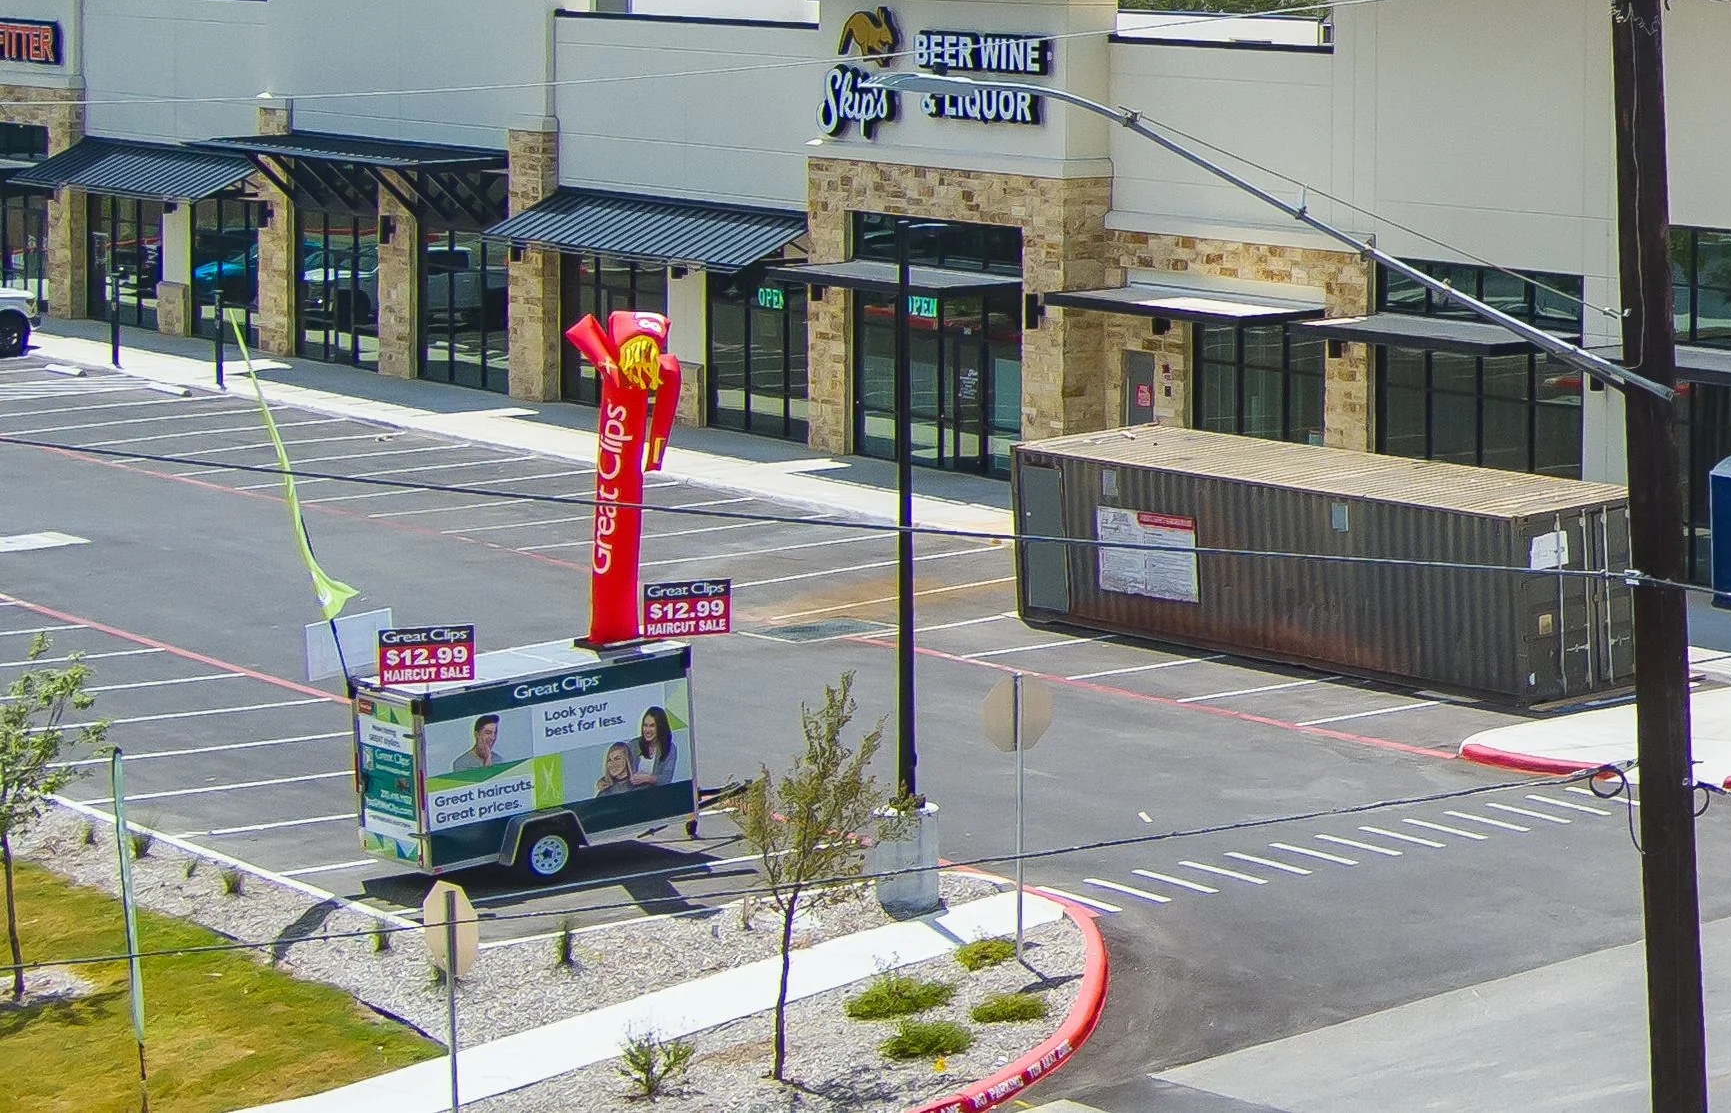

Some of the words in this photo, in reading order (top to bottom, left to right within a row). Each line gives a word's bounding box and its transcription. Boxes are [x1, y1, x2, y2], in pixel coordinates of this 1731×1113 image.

[914, 34, 974, 70] BEER
[980, 36, 1041, 73] WINE
[817, 64, 890, 136] Skip's
[944, 90, 1032, 121] LIQUOR
[758, 287, 785, 310] OPEN
[598, 404, 633, 481] Clips
[592, 487, 619, 575] Great
[647, 586, 689, 598] Great
[691, 582, 725, 597] Clips
[649, 599, 725, 620] $12.99
[382, 631, 428, 643] Great
[430, 629, 468, 643] Clips
[647, 620, 696, 635] HAIRCUT
[698, 619, 727, 632] SALE
[386, 646, 468, 666] $12.99
[383, 667, 437, 682] HAIRCUT
[440, 666, 470, 679] SALE
[513, 682, 560, 699] Great
[561, 675, 600, 691] Clips
[544, 706, 577, 722] Look
[578, 702, 608, 719] your
[544, 723, 575, 739] best
[576, 719, 597, 733] for
[598, 715, 626, 728] less.
[434, 791, 475, 807] Great
[477, 779, 535, 800] haircuts.
[435, 807, 476, 824] Great
[478, 799, 523, 819] prices.
[988, 1076, 1025, 1101] PARKING
